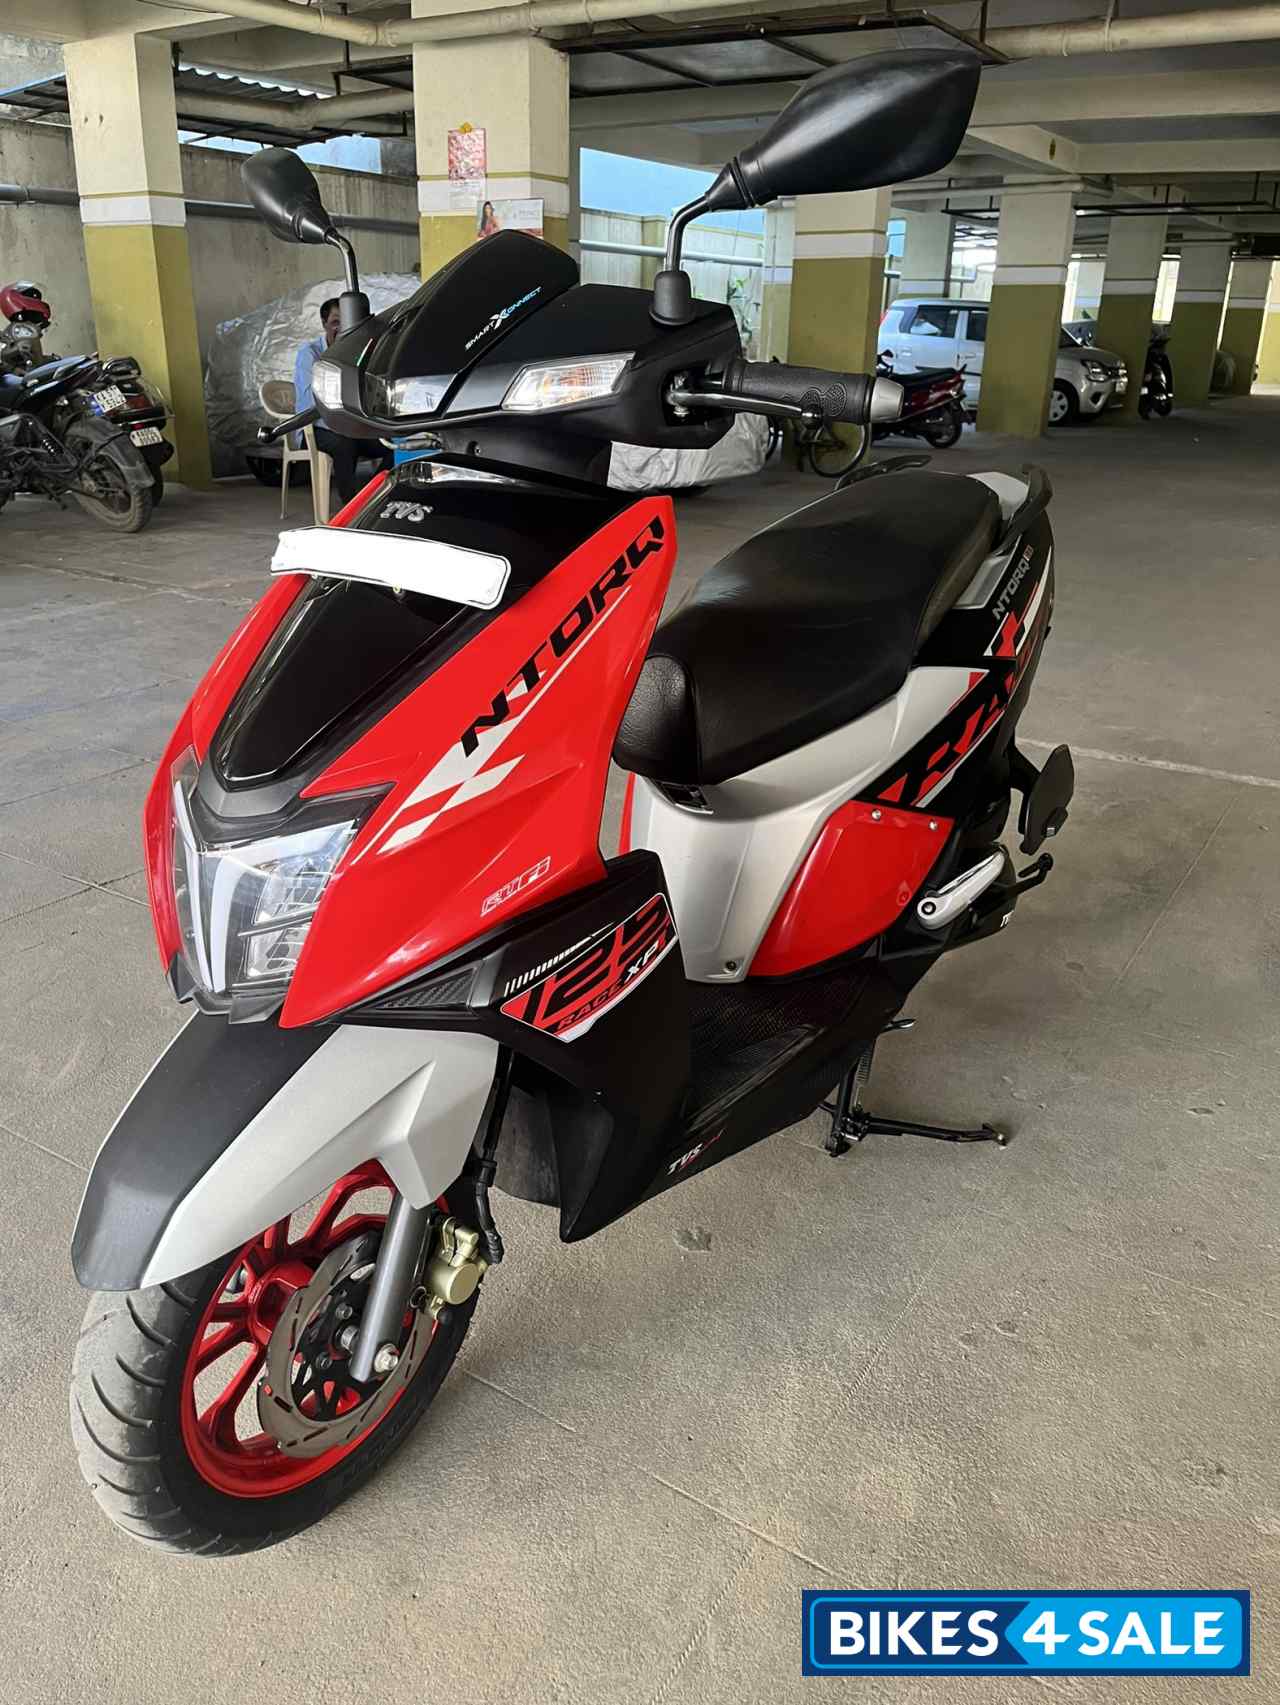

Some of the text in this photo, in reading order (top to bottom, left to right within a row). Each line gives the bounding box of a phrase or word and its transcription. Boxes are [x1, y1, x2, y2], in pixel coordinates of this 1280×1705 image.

[380, 500, 433, 521] TVS
[992, 558, 1030, 621] NTORQ
[460, 515, 664, 758] NTORQ
